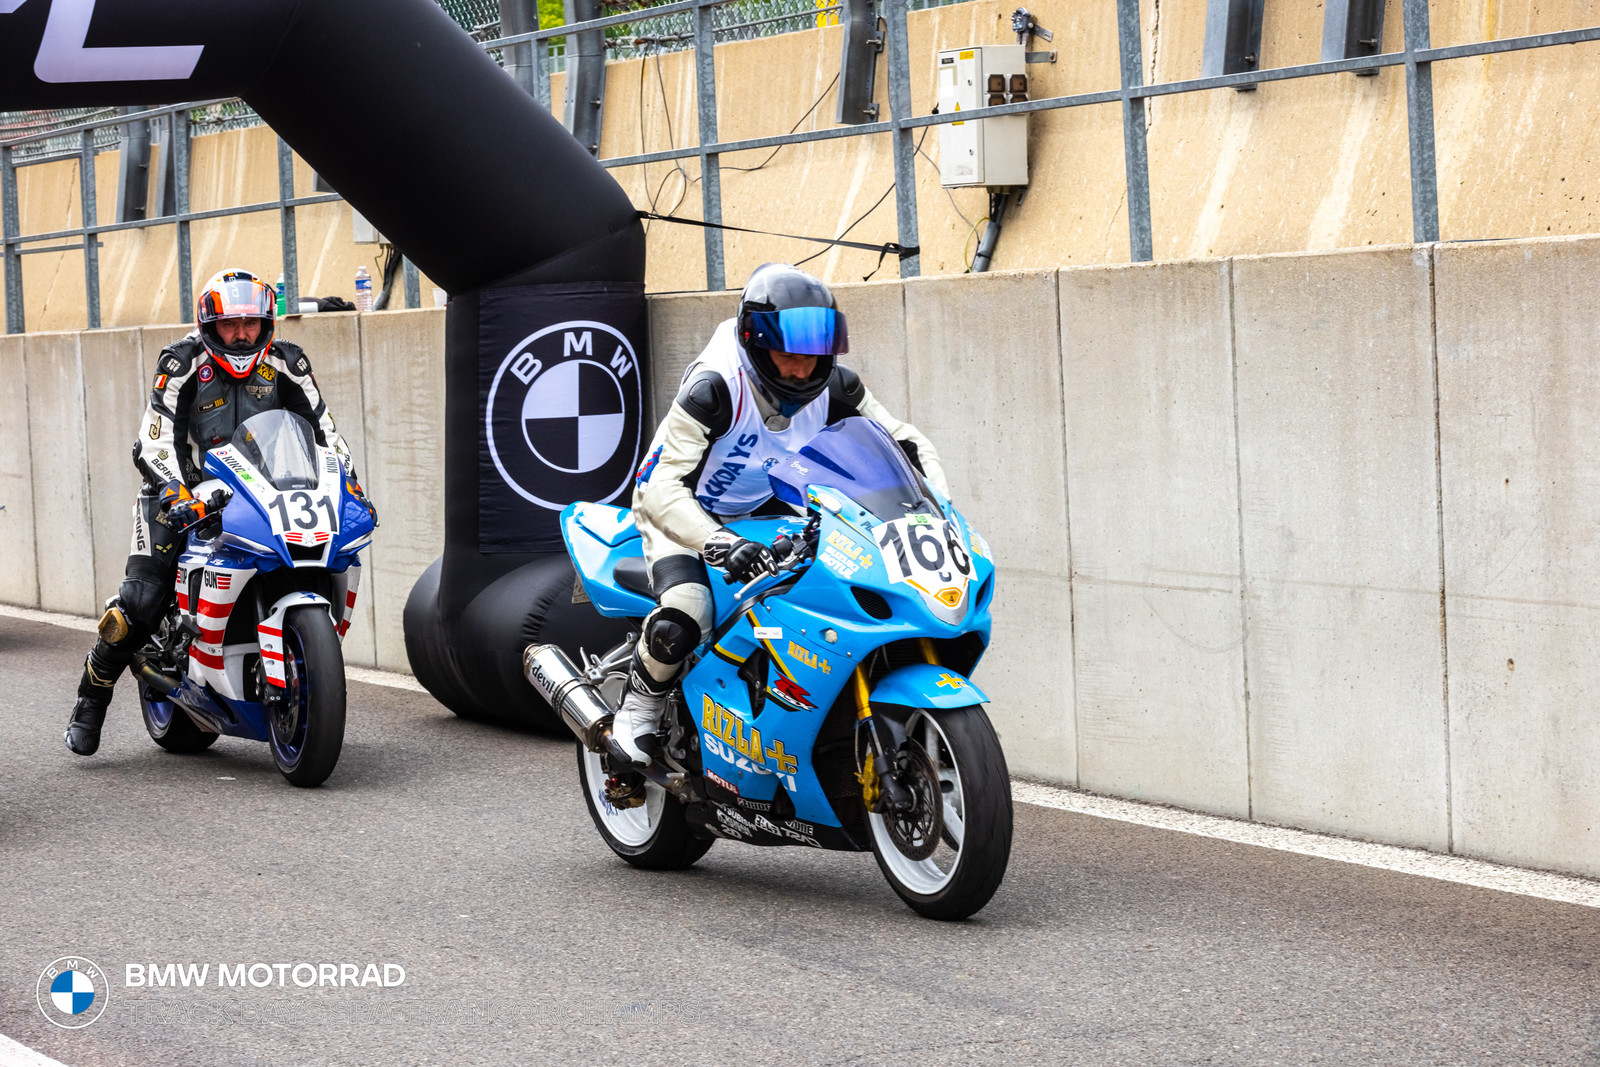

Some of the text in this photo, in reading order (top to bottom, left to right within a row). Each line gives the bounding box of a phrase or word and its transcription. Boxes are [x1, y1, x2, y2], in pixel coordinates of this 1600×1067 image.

[510, 331, 633, 385] BMW
[151, 458, 177, 482] BERIN
[696, 433, 759, 511] ACKDAYS
[268, 491, 338, 533] 131
[879, 519, 971, 578] 166
[204, 569, 218, 589] GUN
[532, 664, 557, 694] devil
[703, 732, 798, 793] SUZUI
[706, 768, 739, 795] MOTUL
